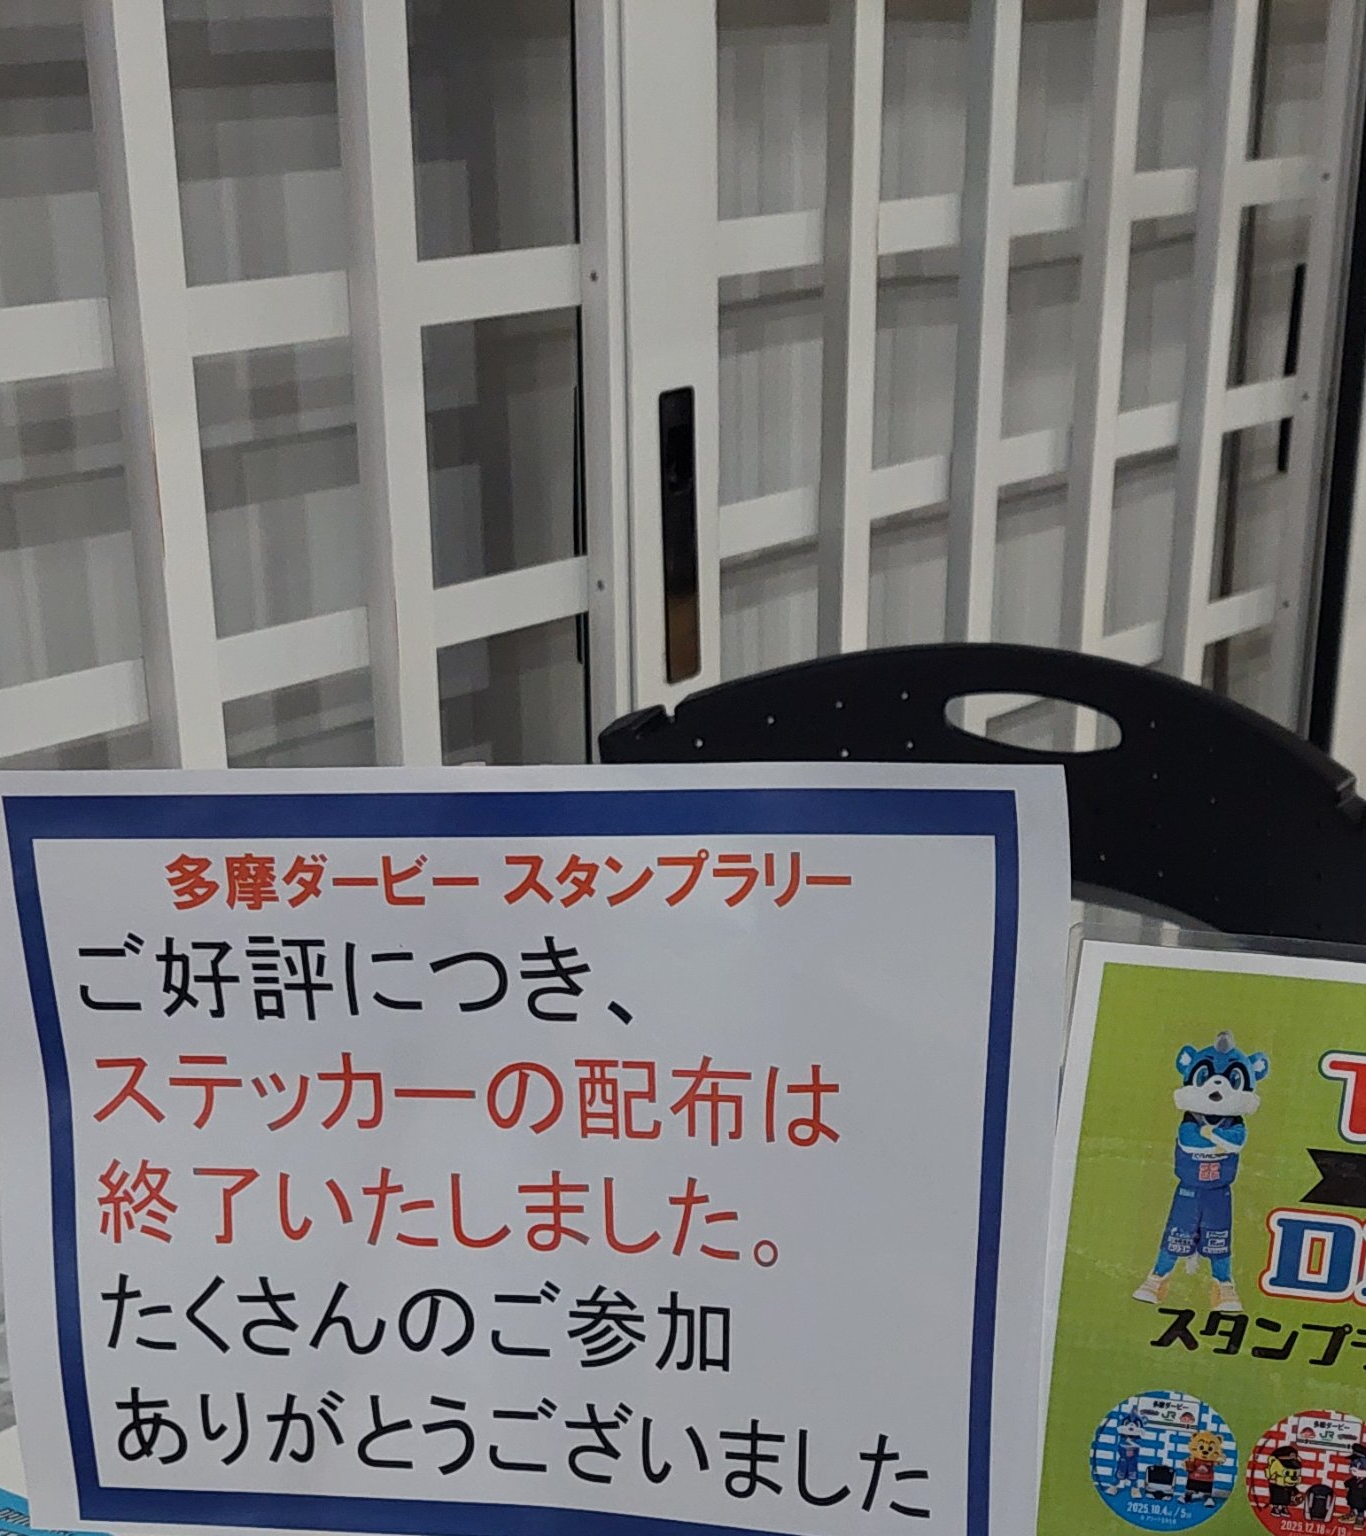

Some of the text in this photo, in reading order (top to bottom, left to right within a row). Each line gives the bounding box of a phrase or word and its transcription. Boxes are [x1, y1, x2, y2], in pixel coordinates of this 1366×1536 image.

[164, 850, 854, 912] 多摩ダービー スタンプラリー
[75, 932, 638, 1026] ご好評につき、
[91, 1050, 843, 1146] ステッカーの配布は
[95, 1157, 781, 1270] 終了いたしました。
[101, 1271, 734, 1374] たくさんのご参加
[115, 1383, 935, 1520] ありがとうございました
